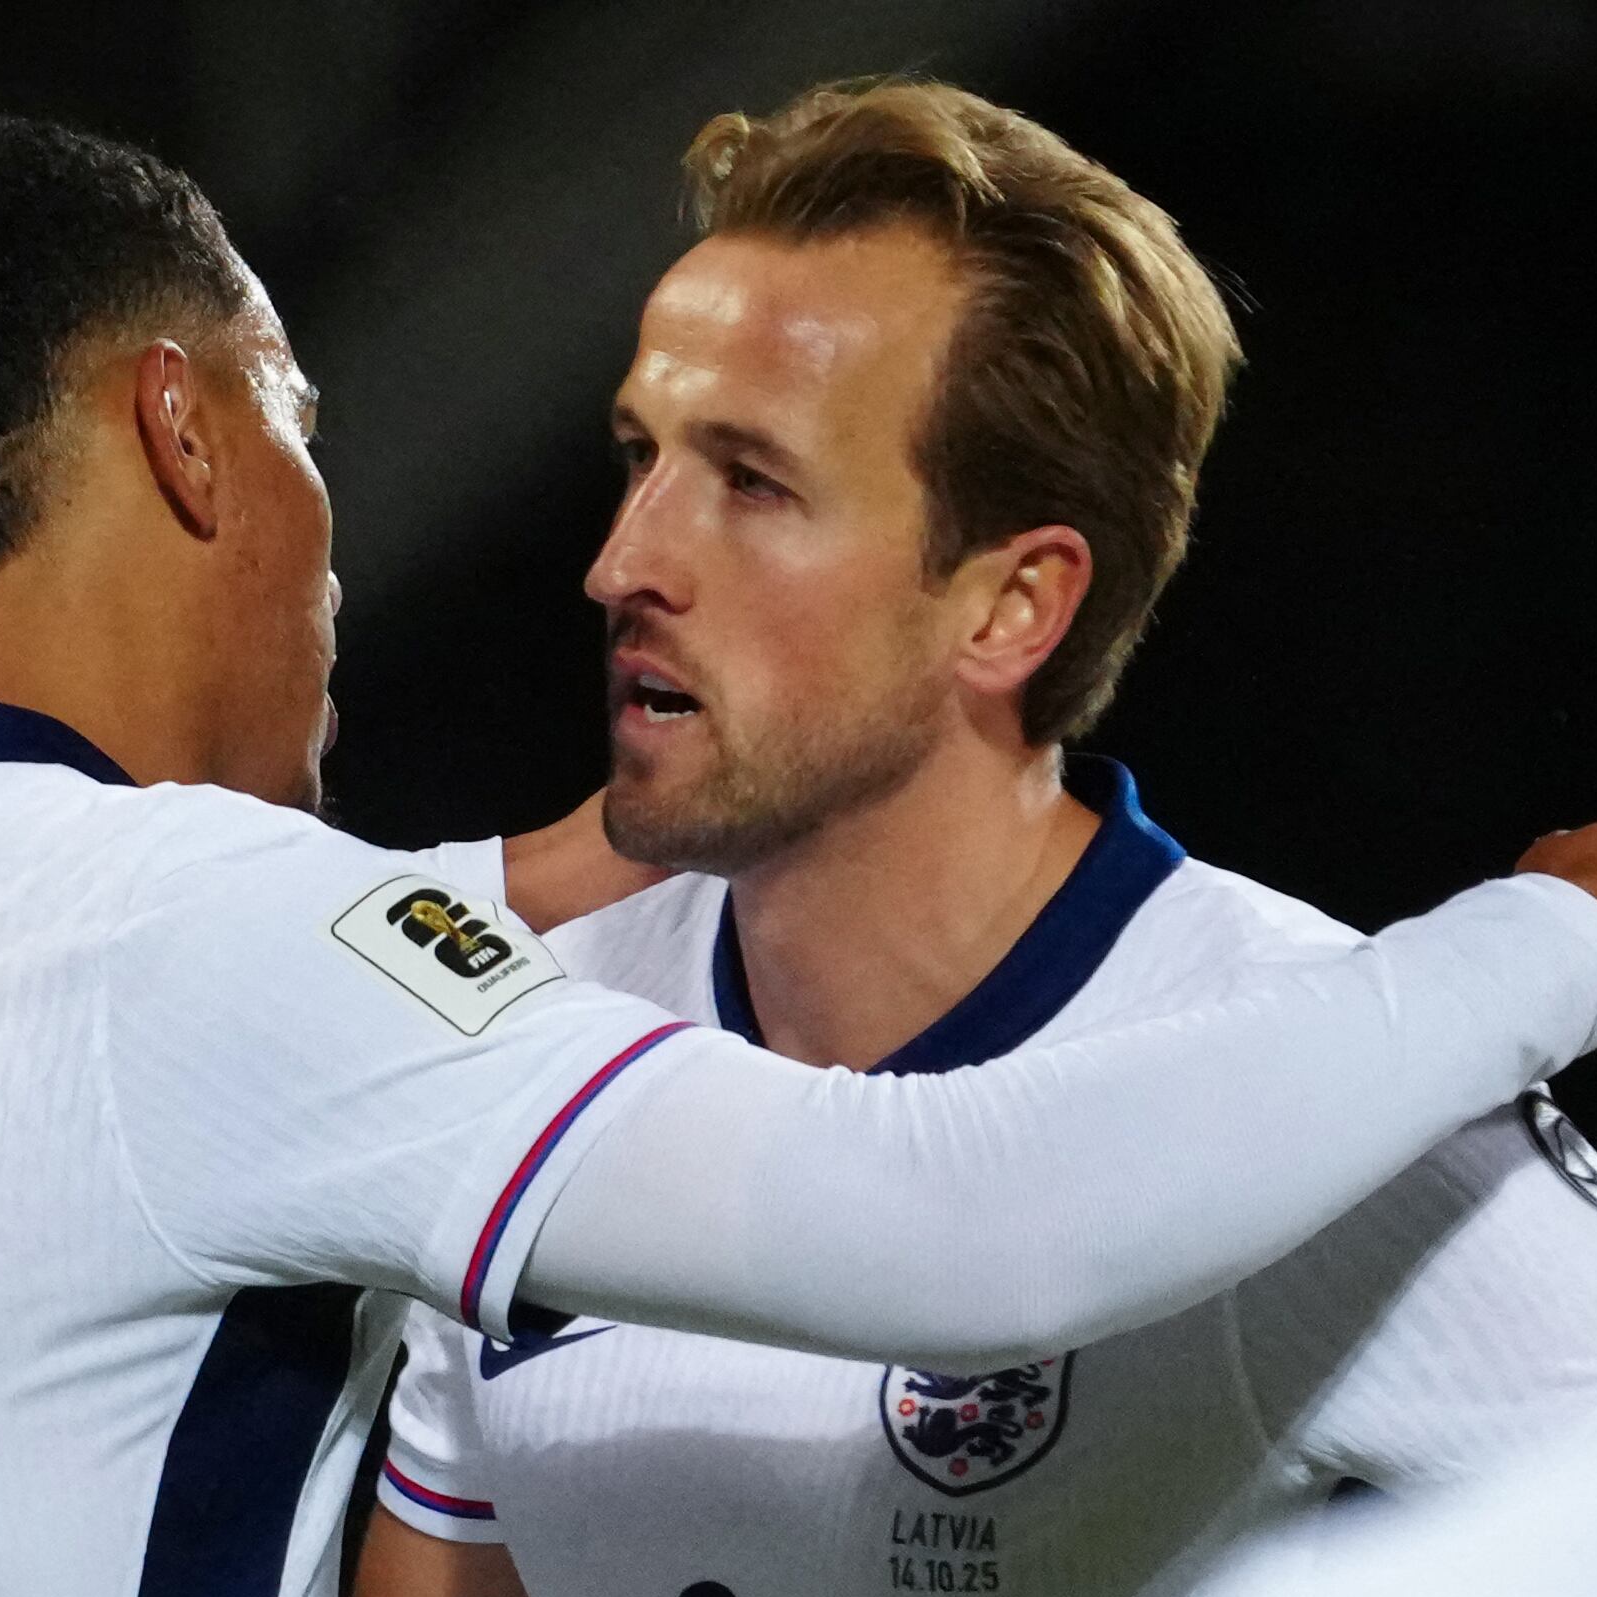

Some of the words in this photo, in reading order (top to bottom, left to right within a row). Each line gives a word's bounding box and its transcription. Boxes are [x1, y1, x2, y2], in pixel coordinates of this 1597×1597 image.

[467, 946, 500, 970] FIFA
[890, 1509, 996, 1551] LATVIA
[888, 1555, 1000, 1593] 14.10.25
